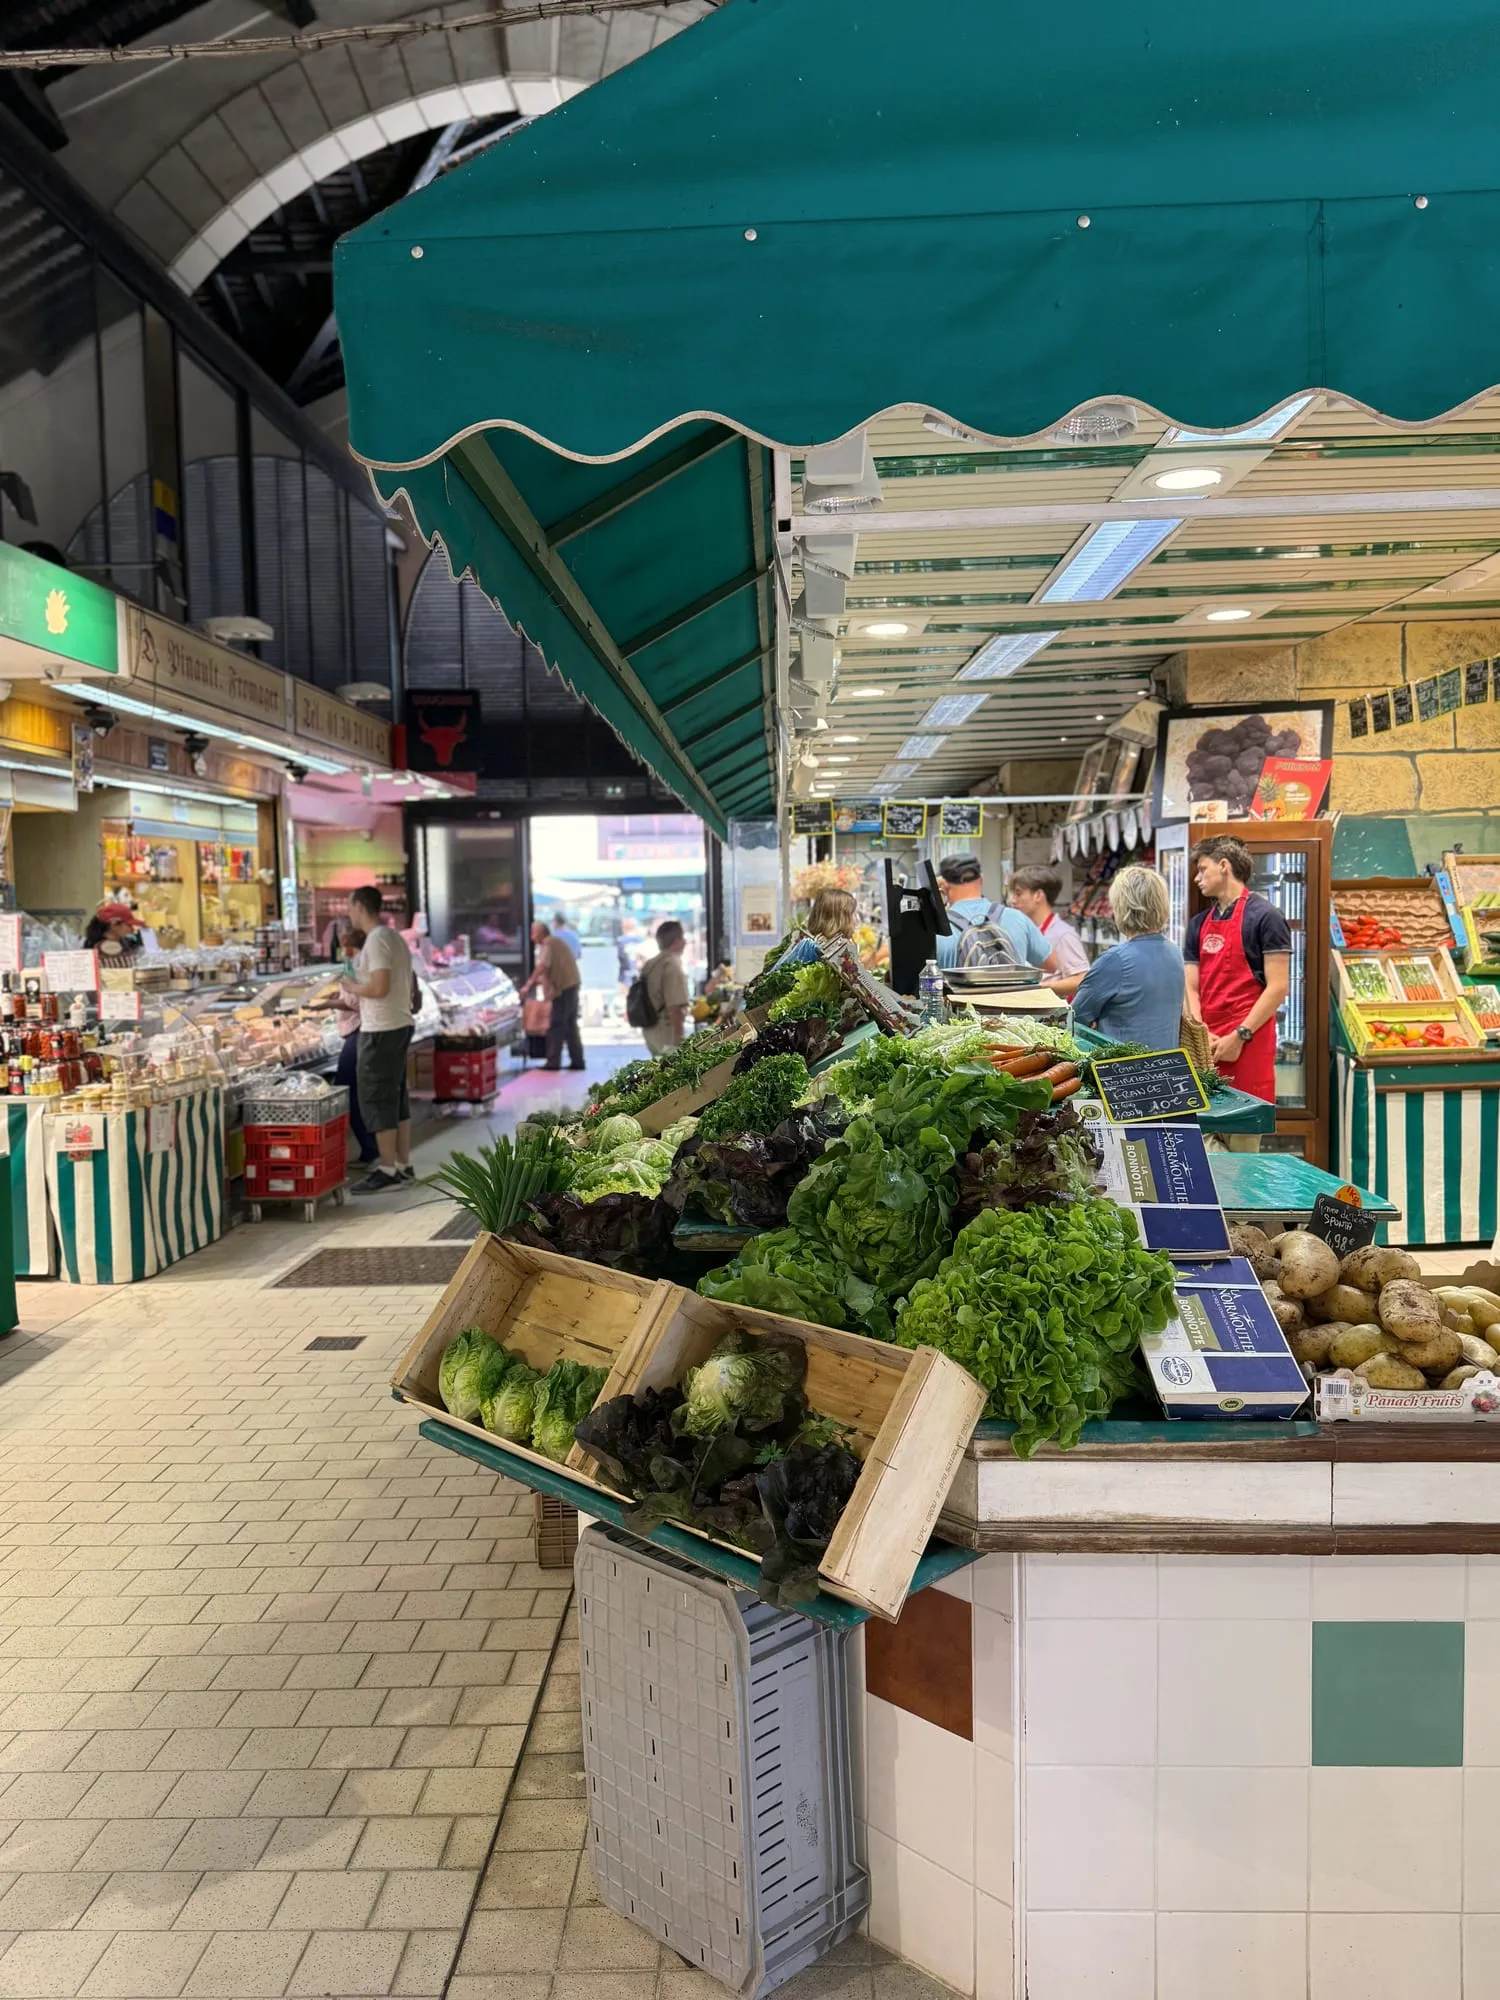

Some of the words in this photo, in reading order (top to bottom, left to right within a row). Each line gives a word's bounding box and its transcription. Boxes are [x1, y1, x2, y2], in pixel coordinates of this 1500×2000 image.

[1113, 1083, 1163, 1101] FRANCE
[1174, 1133, 1184, 1145] LA
[1126, 1145, 1145, 1197] BONNOTTE
[1161, 1131, 1189, 1204] NOIRMOUTIE
[1178, 1299, 1206, 1346] BONNOTTE
[1217, 1289, 1257, 1353] NOIRMOUTIE
